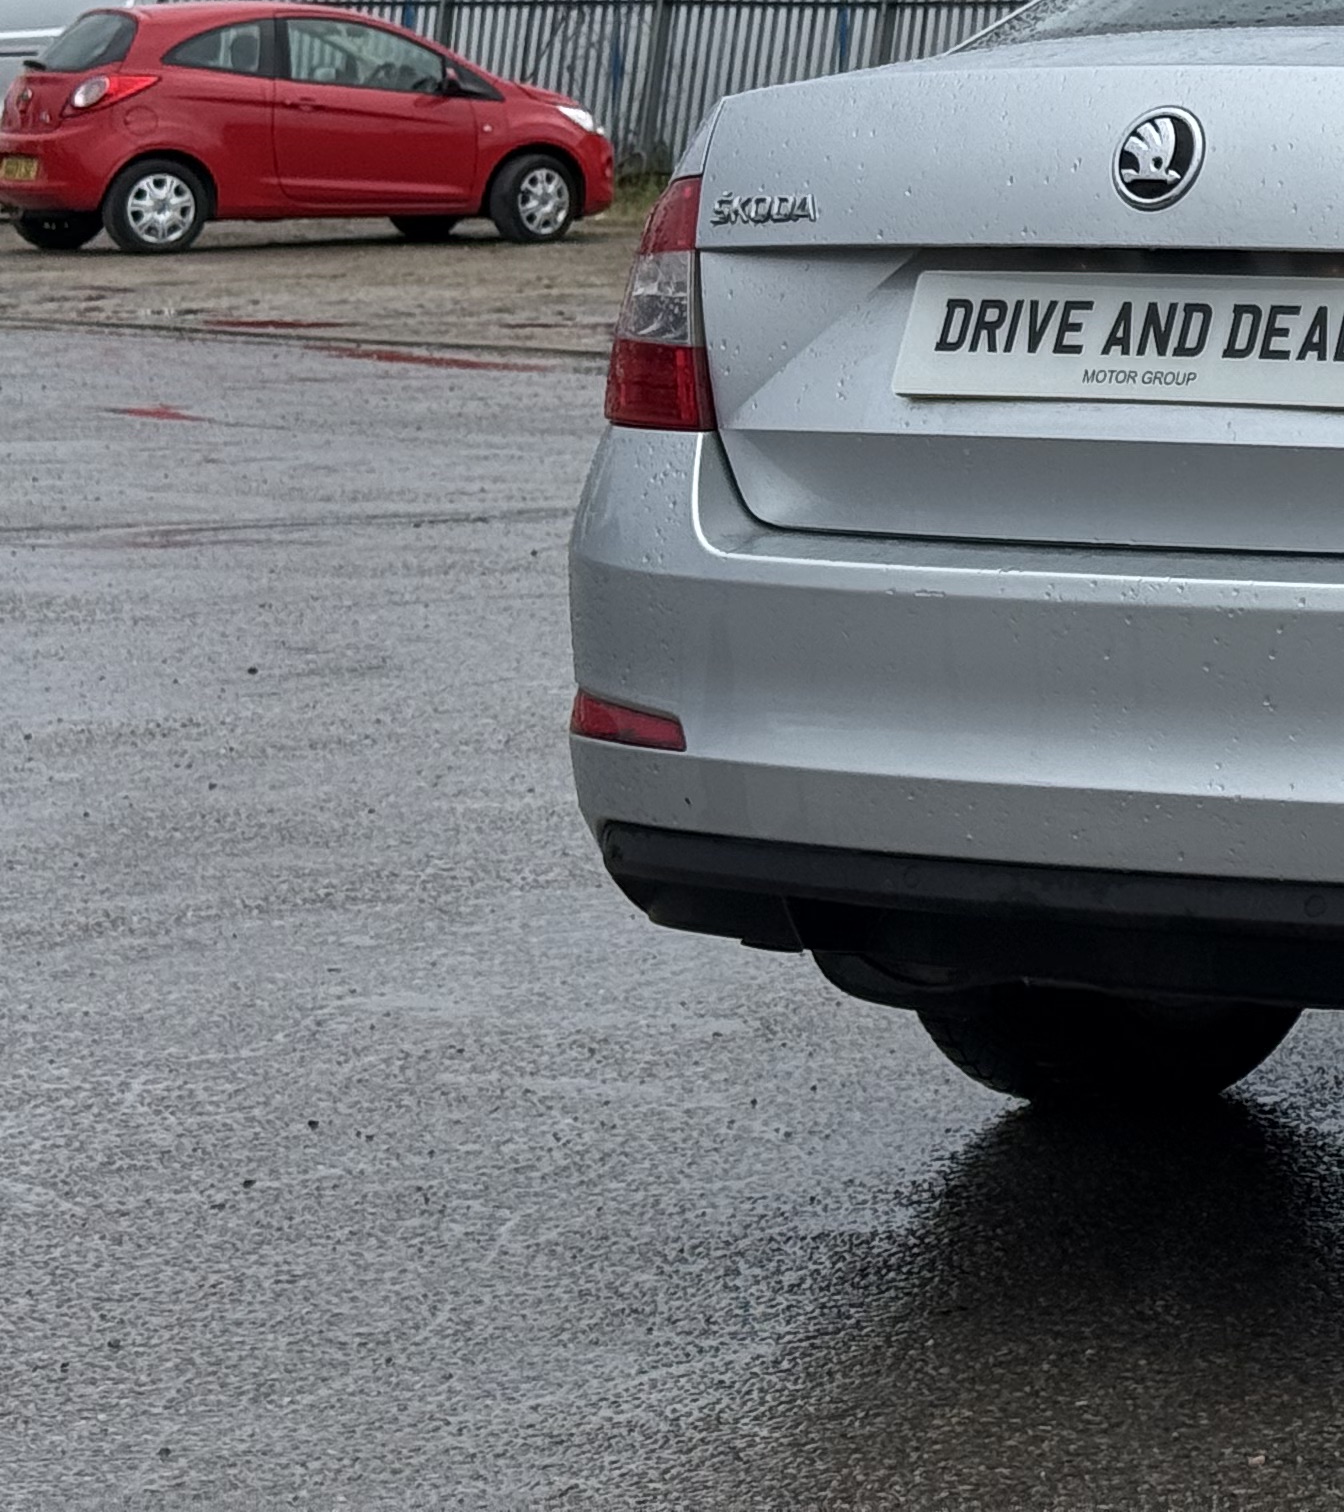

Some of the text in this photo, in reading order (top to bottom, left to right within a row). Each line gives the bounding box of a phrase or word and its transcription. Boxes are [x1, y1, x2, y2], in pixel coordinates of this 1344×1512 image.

[709, 191, 818, 225] ŠKODA
[934, 298, 1095, 355] DRIVE
[1100, 300, 1213, 358] AND
[1082, 369, 1198, 386] MOTOR GROUP
